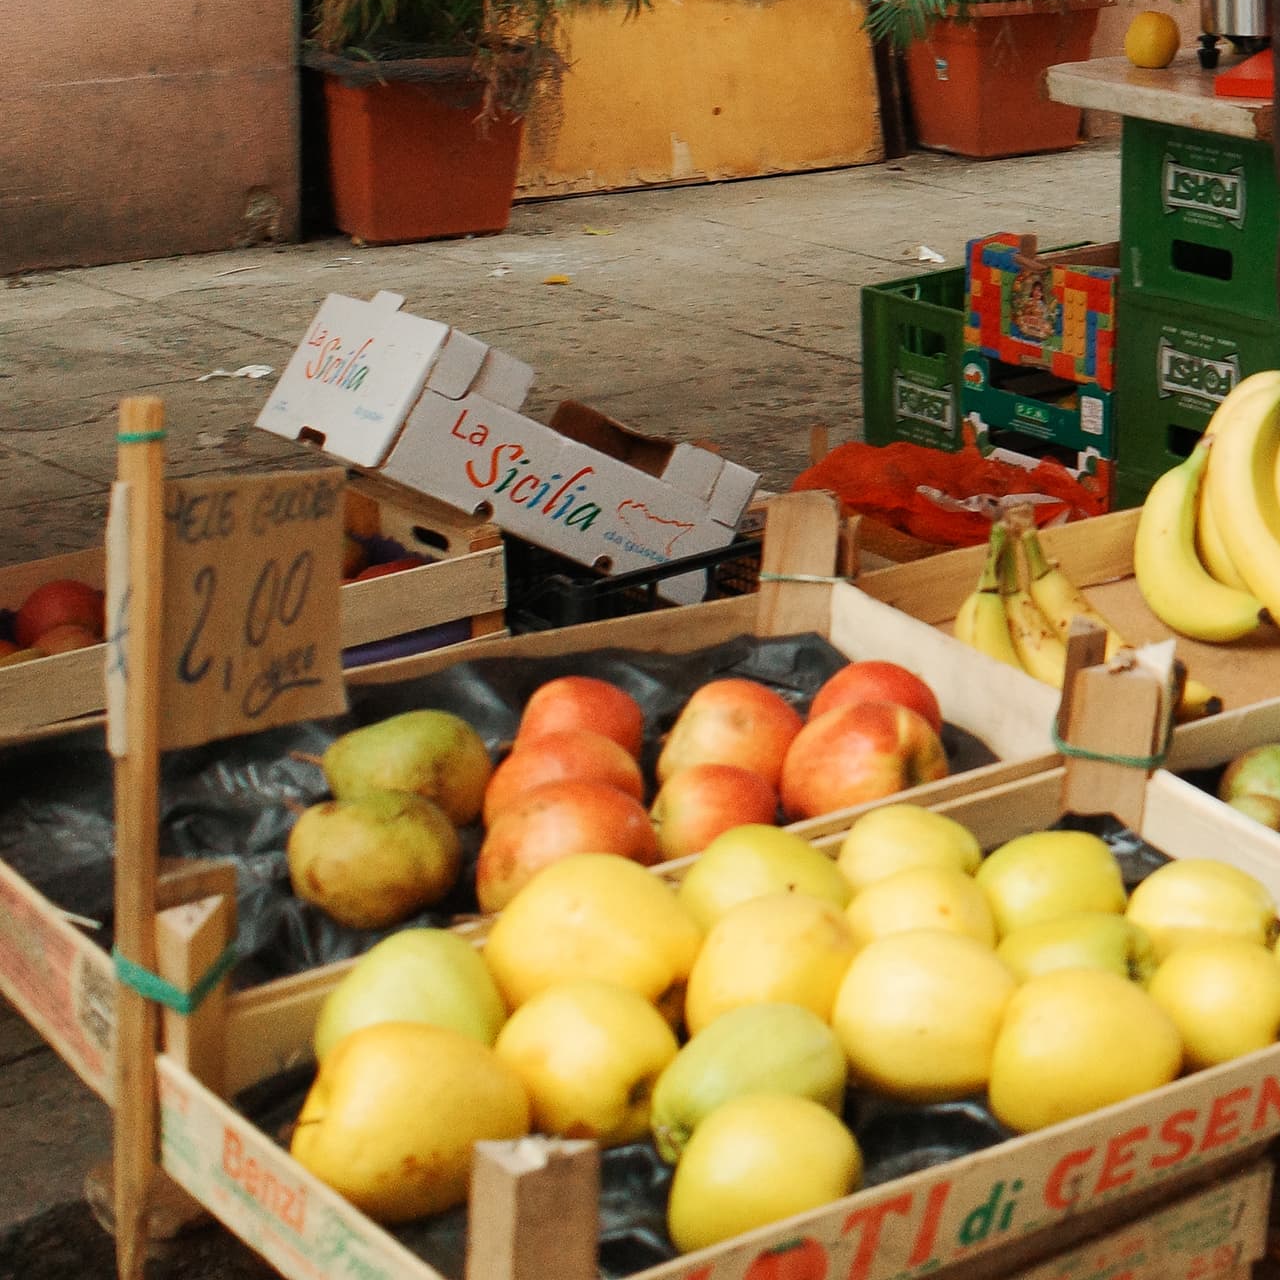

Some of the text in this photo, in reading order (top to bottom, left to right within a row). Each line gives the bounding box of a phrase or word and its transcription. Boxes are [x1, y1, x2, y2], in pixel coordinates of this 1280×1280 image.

[1171, 174, 1238, 211] FORST
[308, 321, 328, 348] La
[305, 336, 374, 392] Sicilia
[1166, 355, 1231, 397] FORST
[451, 408, 491, 448] La
[464, 441, 603, 533] Sicilia
[957, 1178, 1025, 1248] di
